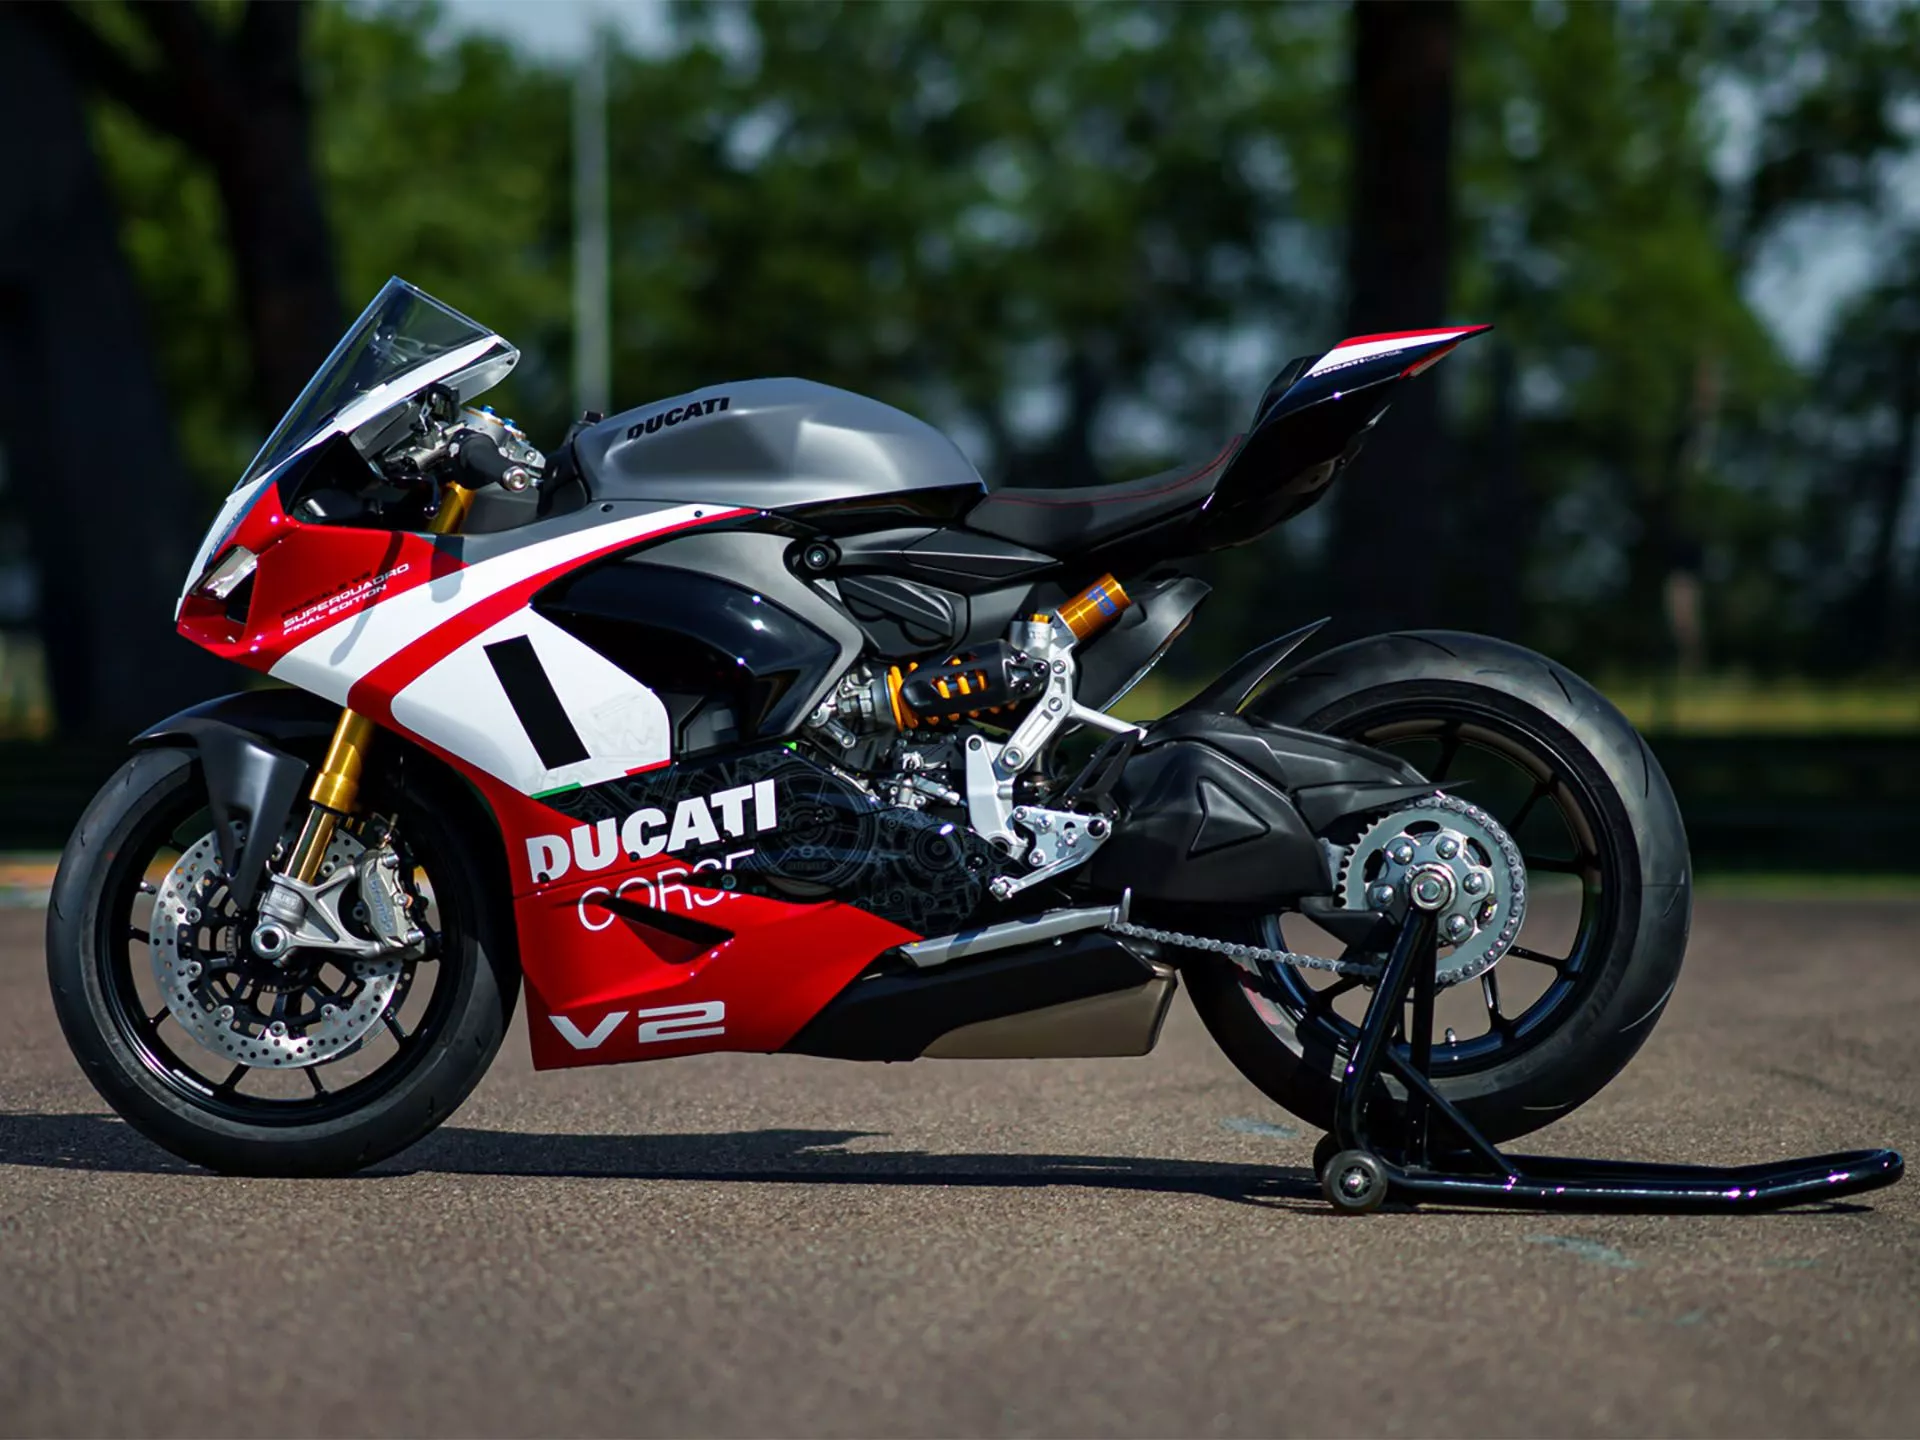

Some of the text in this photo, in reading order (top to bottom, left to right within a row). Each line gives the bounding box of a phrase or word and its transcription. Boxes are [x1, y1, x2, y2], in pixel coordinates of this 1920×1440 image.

[627, 397, 730, 440] DUCATI
[283, 563, 409, 628] SUPERQUADRO
[283, 614, 326, 635] FINAL
[328, 584, 387, 615] EDITION
[526, 779, 777, 884] DUCATI
[548, 1000, 725, 1050] V2
